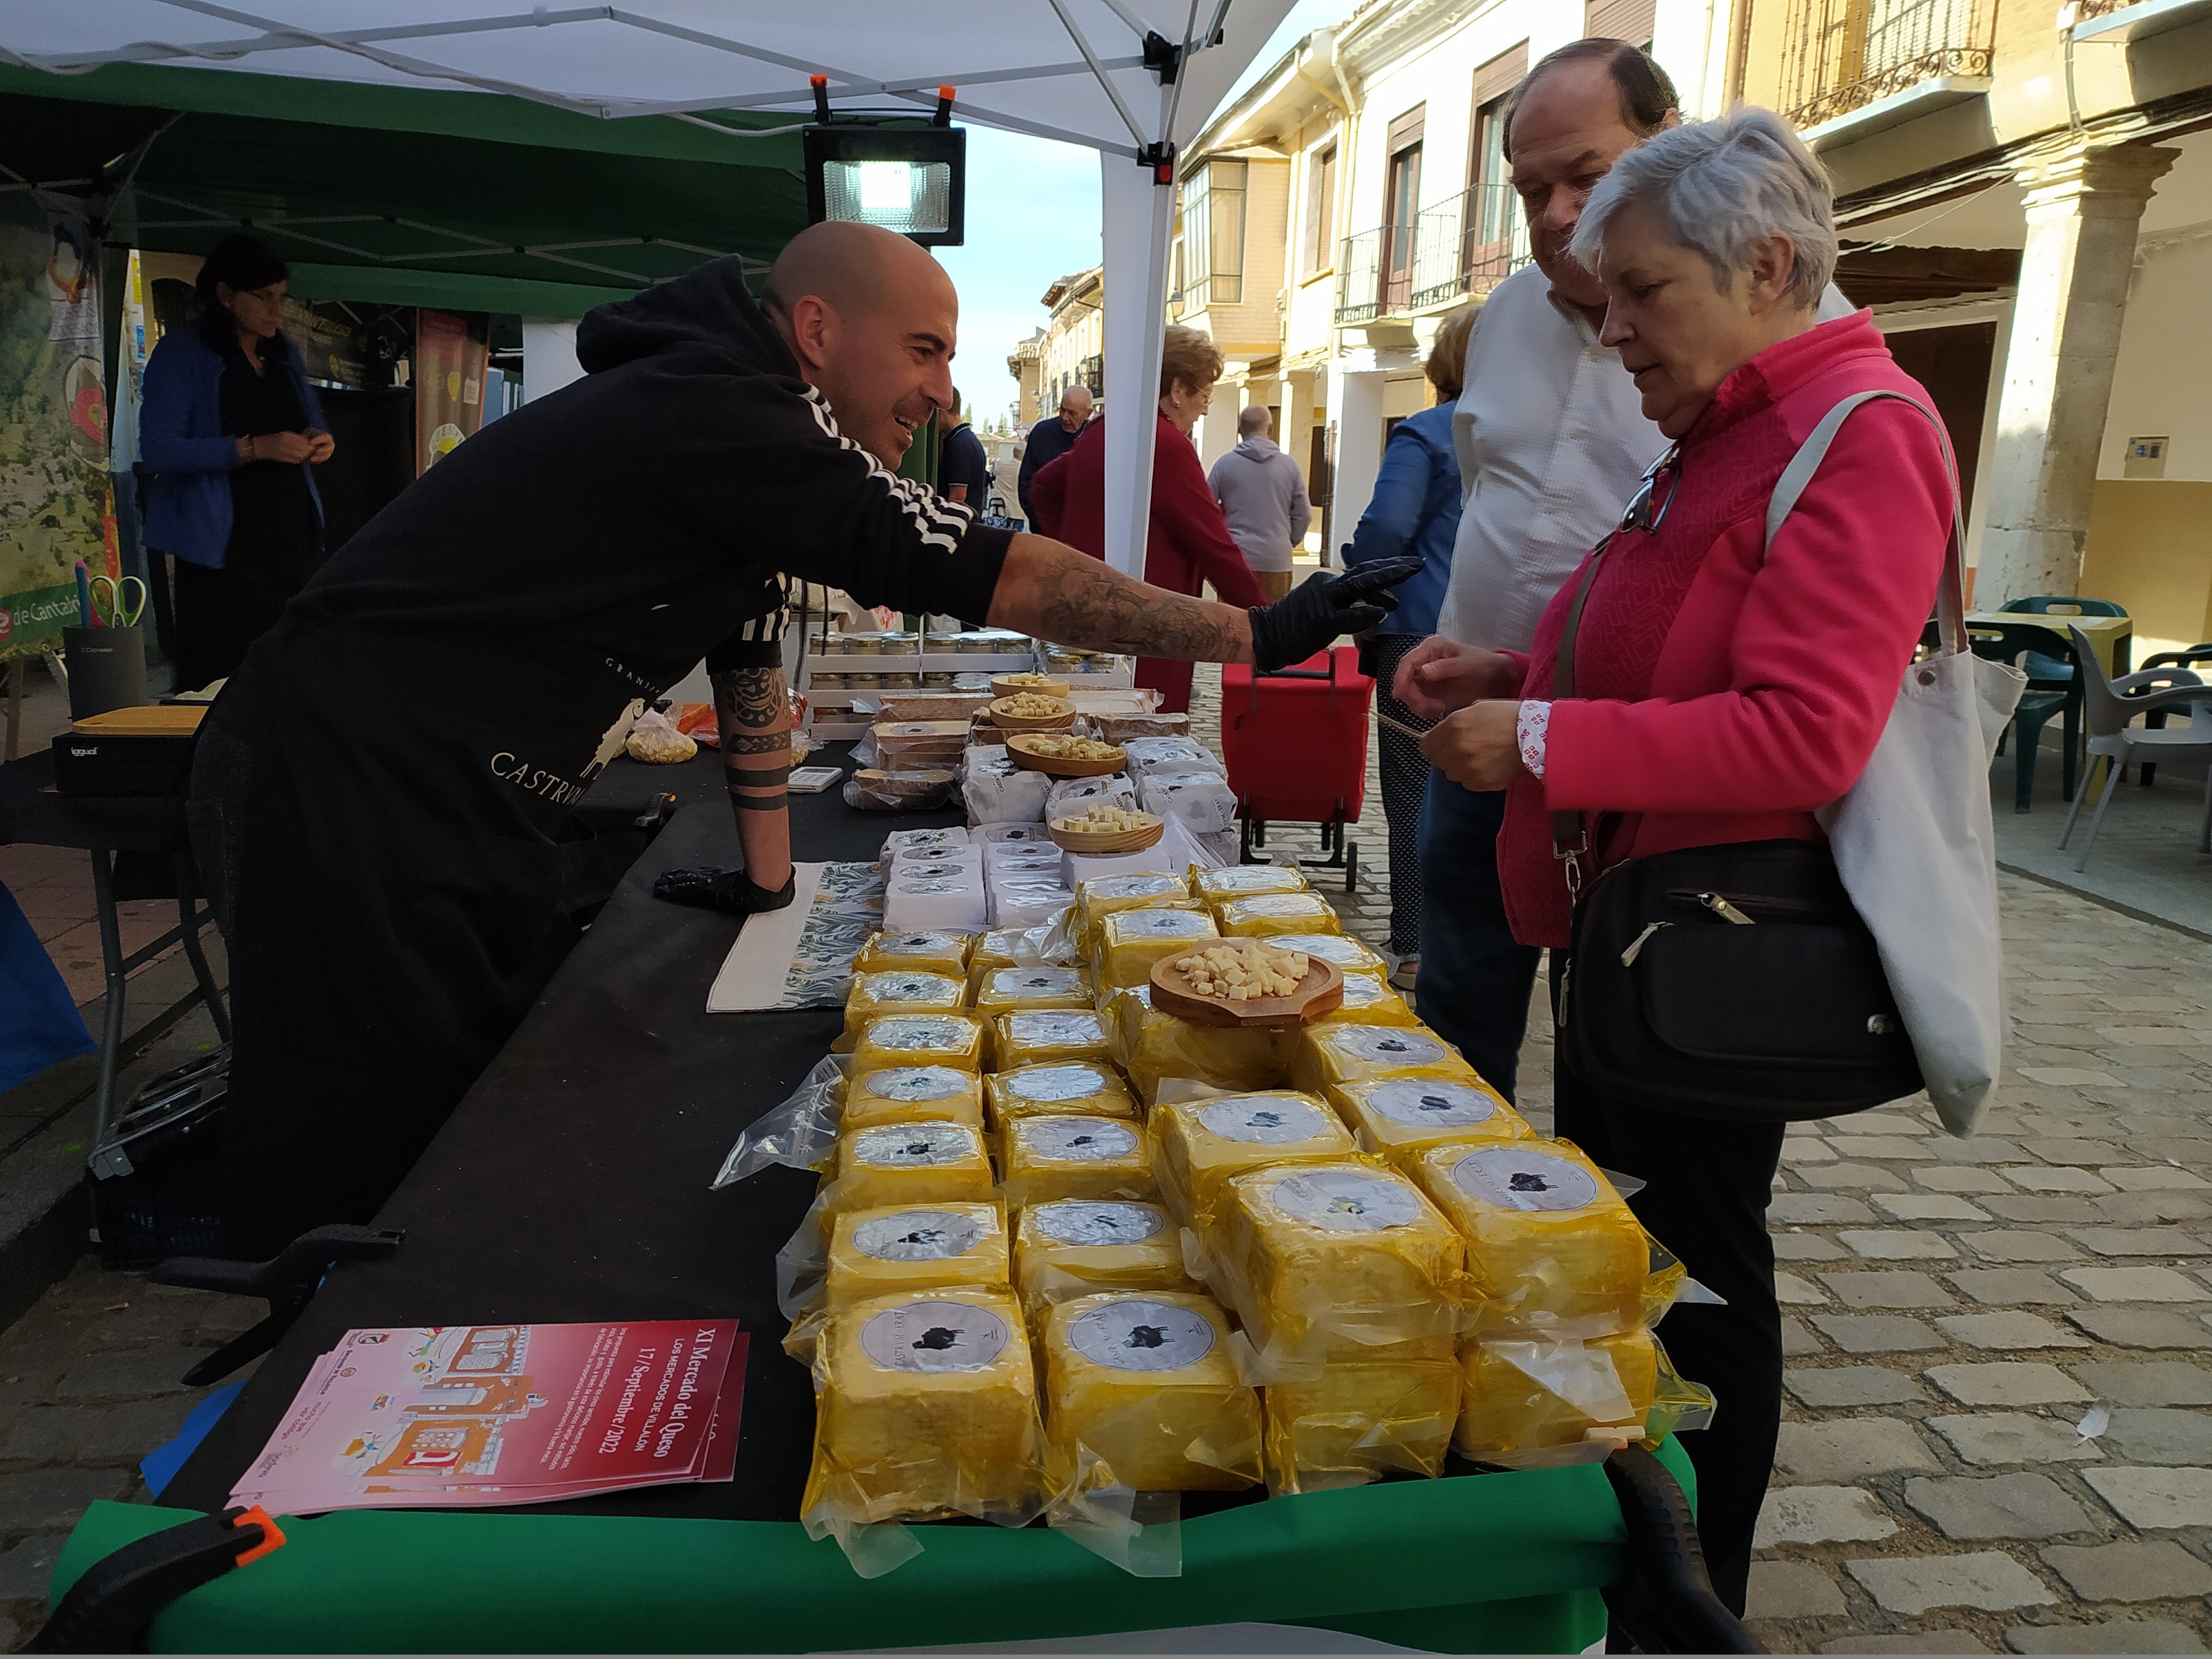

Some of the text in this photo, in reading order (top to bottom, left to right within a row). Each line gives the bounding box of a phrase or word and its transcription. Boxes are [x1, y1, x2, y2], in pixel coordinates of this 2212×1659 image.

[30, 594, 81, 622] Cantabri
[576, 1364, 593, 1389] importancia
[589, 1396, 600, 1407] cinco
[598, 1347, 656, 1454] 17/Septiembre/2022
[634, 1338, 685, 1452] LOS MERCADOS DE VILLALÓN
[653, 1328, 716, 1458] XI Mercado del Queso
[296, 1401, 322, 1432] mucho que
[570, 1406, 585, 1424] delicioso
